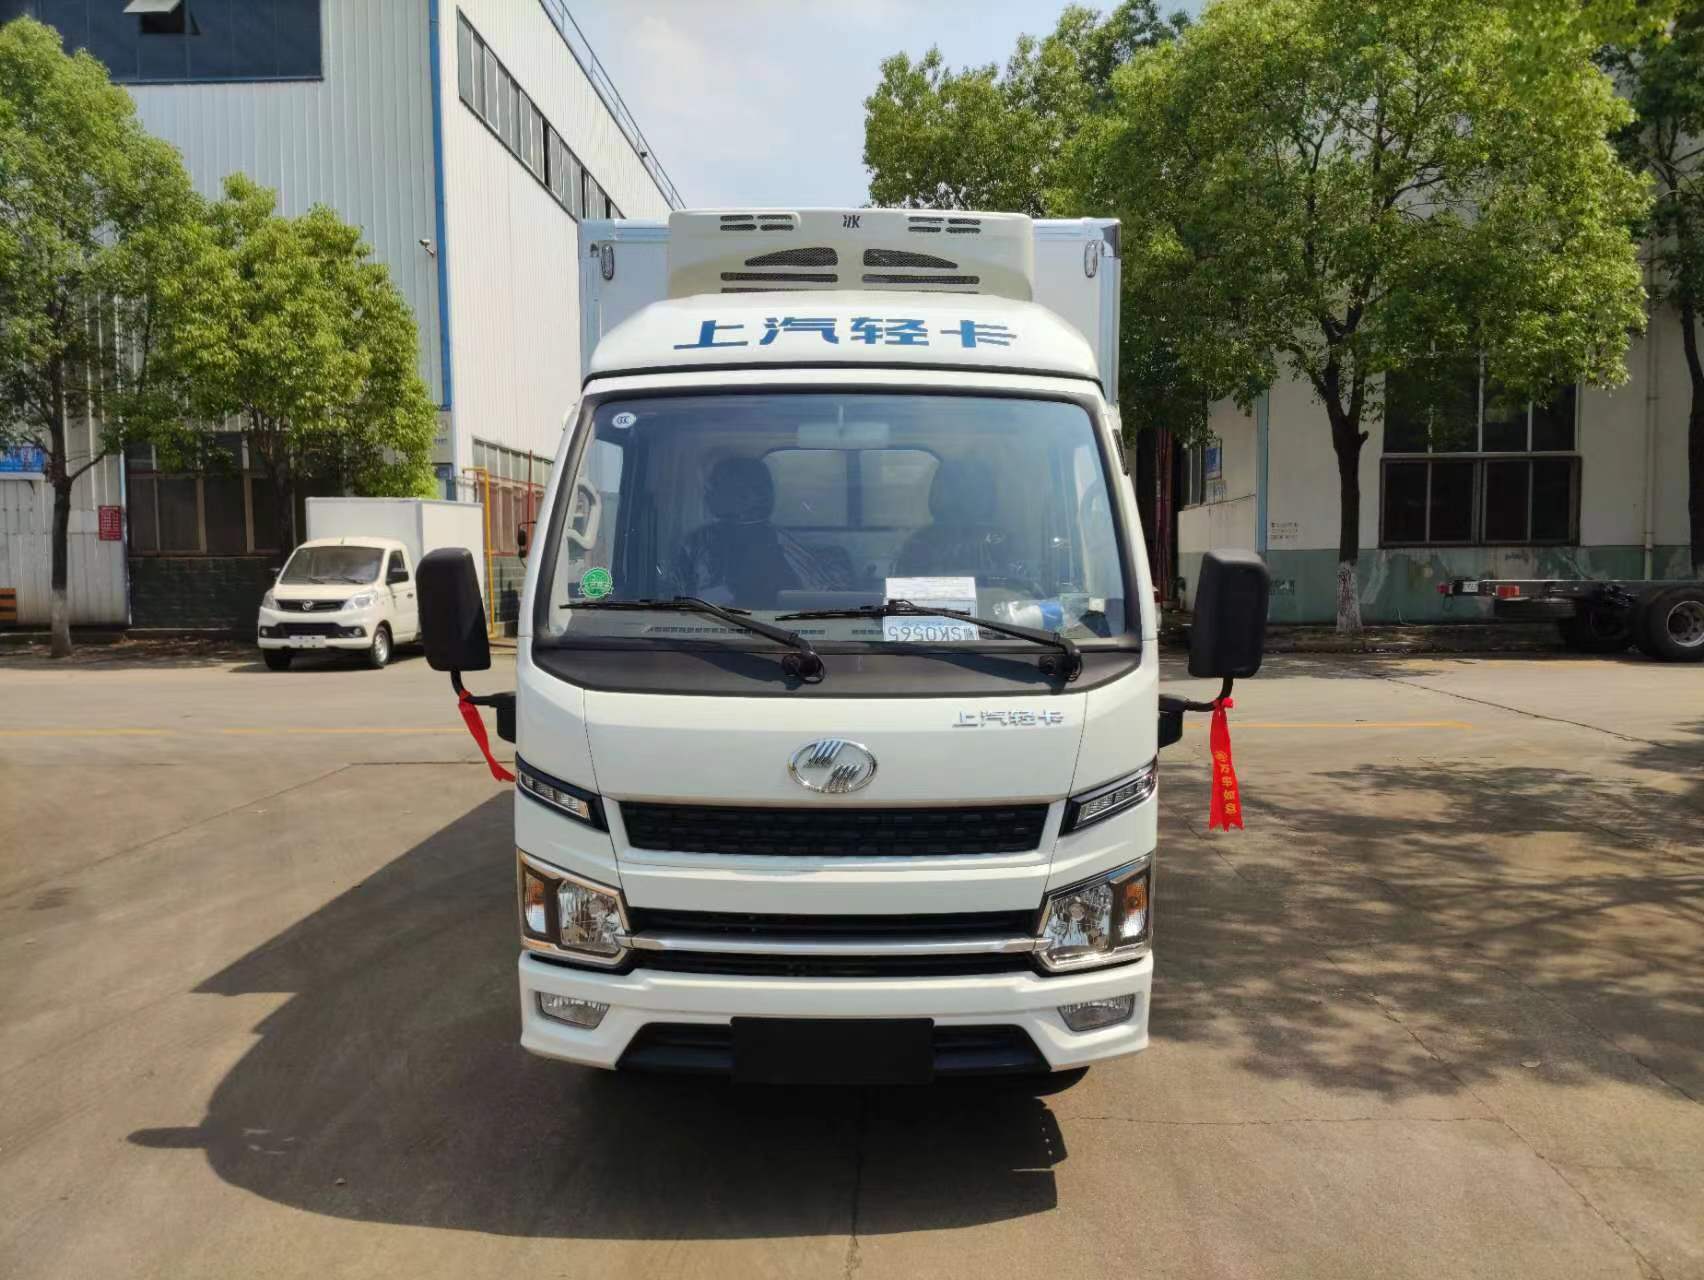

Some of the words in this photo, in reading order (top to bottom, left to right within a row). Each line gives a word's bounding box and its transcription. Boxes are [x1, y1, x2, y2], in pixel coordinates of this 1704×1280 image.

[673, 316, 1017, 350] 上汽轻卡
[952, 709, 1064, 728] 上汽轻卡
